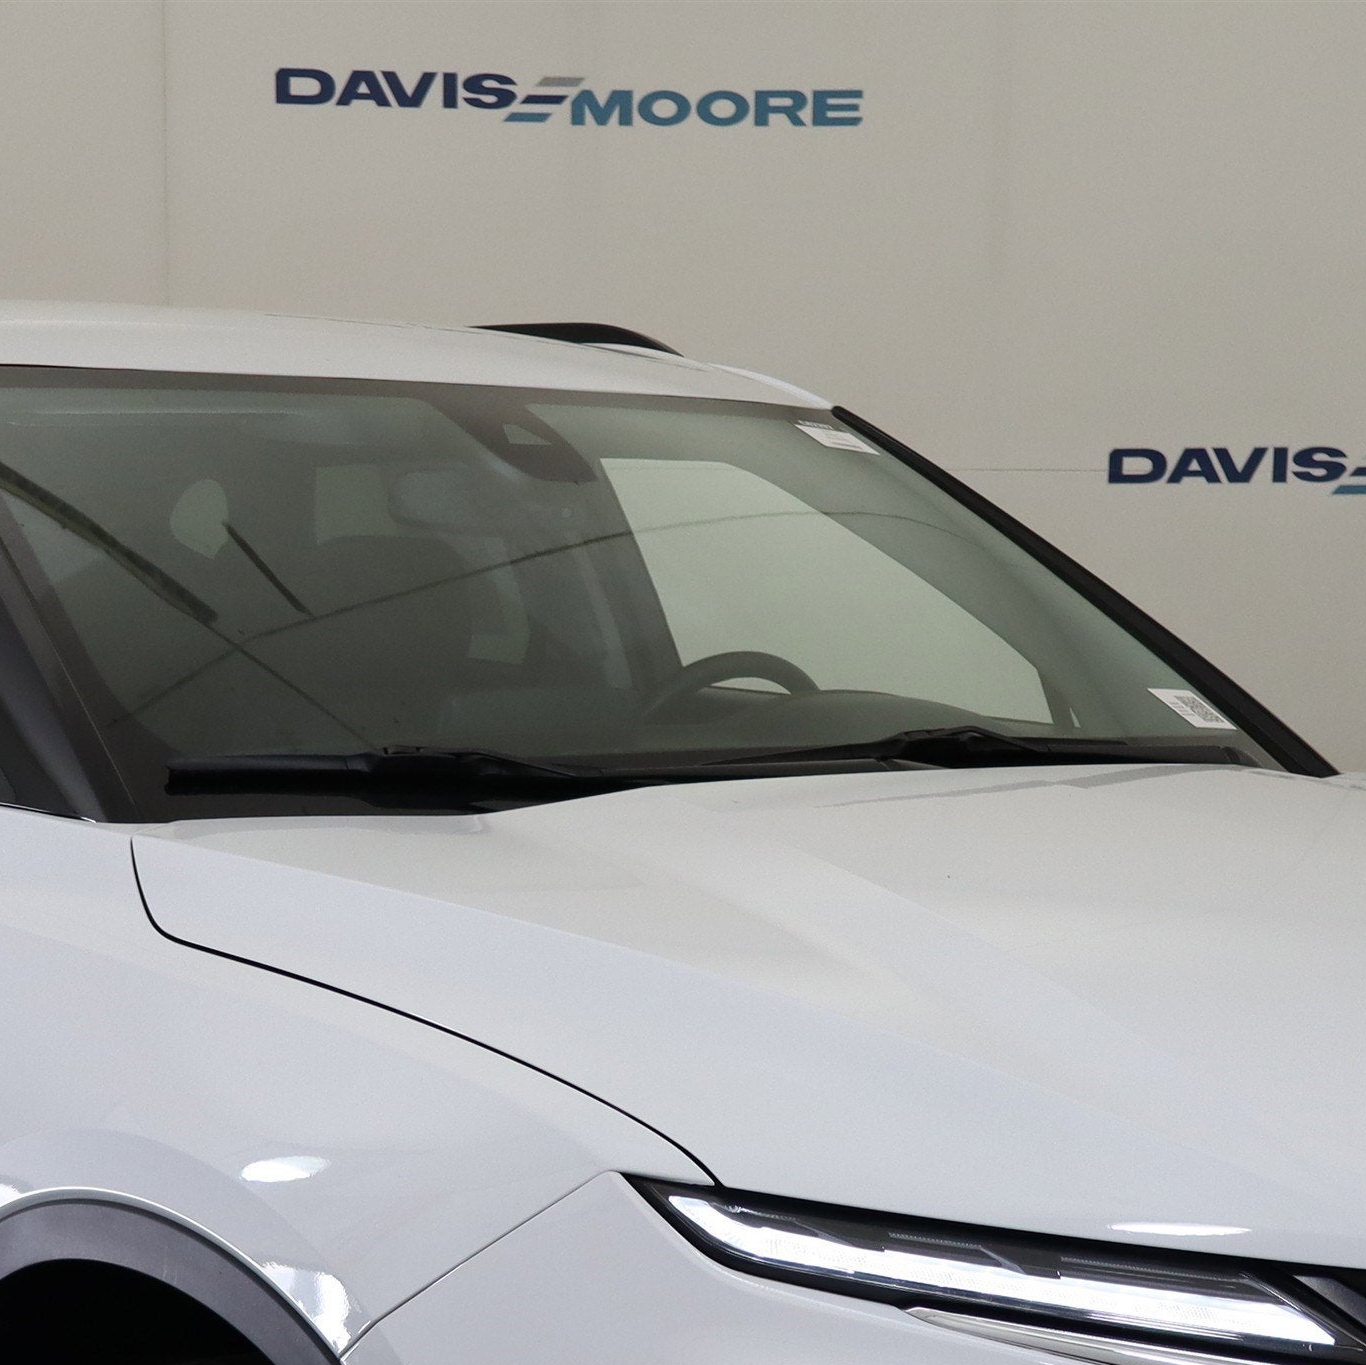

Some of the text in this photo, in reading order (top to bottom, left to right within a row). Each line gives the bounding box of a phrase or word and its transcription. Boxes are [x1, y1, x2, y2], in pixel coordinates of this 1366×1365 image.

[275, 67, 863, 127] DAVIS MOORE
[1108, 447, 1347, 484] DAVIS
